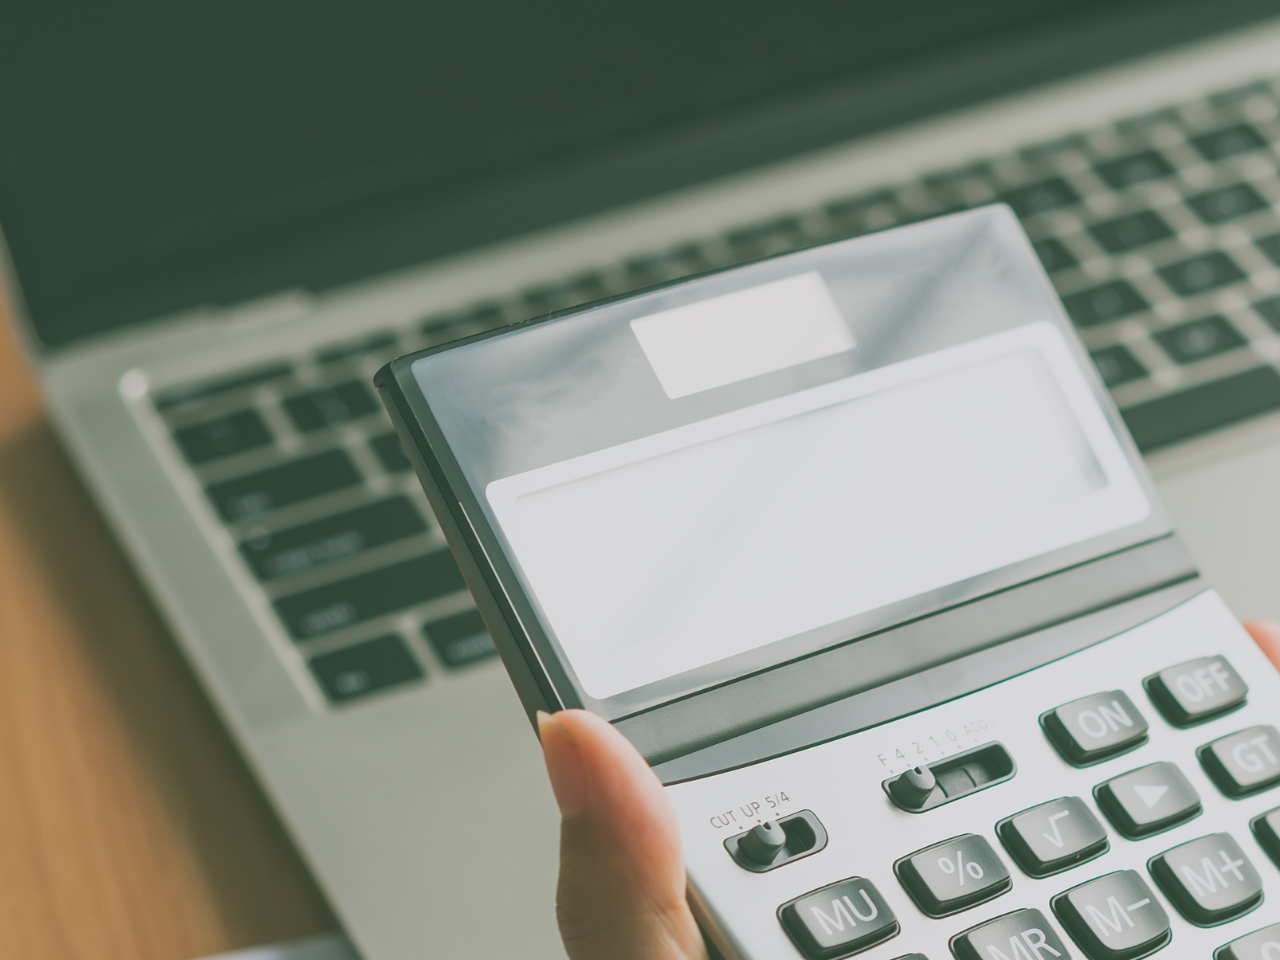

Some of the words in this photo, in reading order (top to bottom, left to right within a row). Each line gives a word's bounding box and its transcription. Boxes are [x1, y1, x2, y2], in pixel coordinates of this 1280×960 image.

[1177, 663, 1231, 700] OFF
[1077, 700, 1129, 738] ON
[877, 753, 886, 767] F
[895, 748, 905, 760] 4
[911, 741, 924, 754] 2
[928, 735, 939, 747] 1
[945, 729, 957, 742] 0
[1234, 734, 1277, 772] GT
[710, 810, 737, 829] CUT
[739, 801, 761, 818] UP
[764, 791, 790, 809] 5/4
[938, 849, 984, 887] %
[1180, 854, 1244, 896] M+
[812, 889, 878, 935] MU
[1085, 896, 1151, 936] M-
